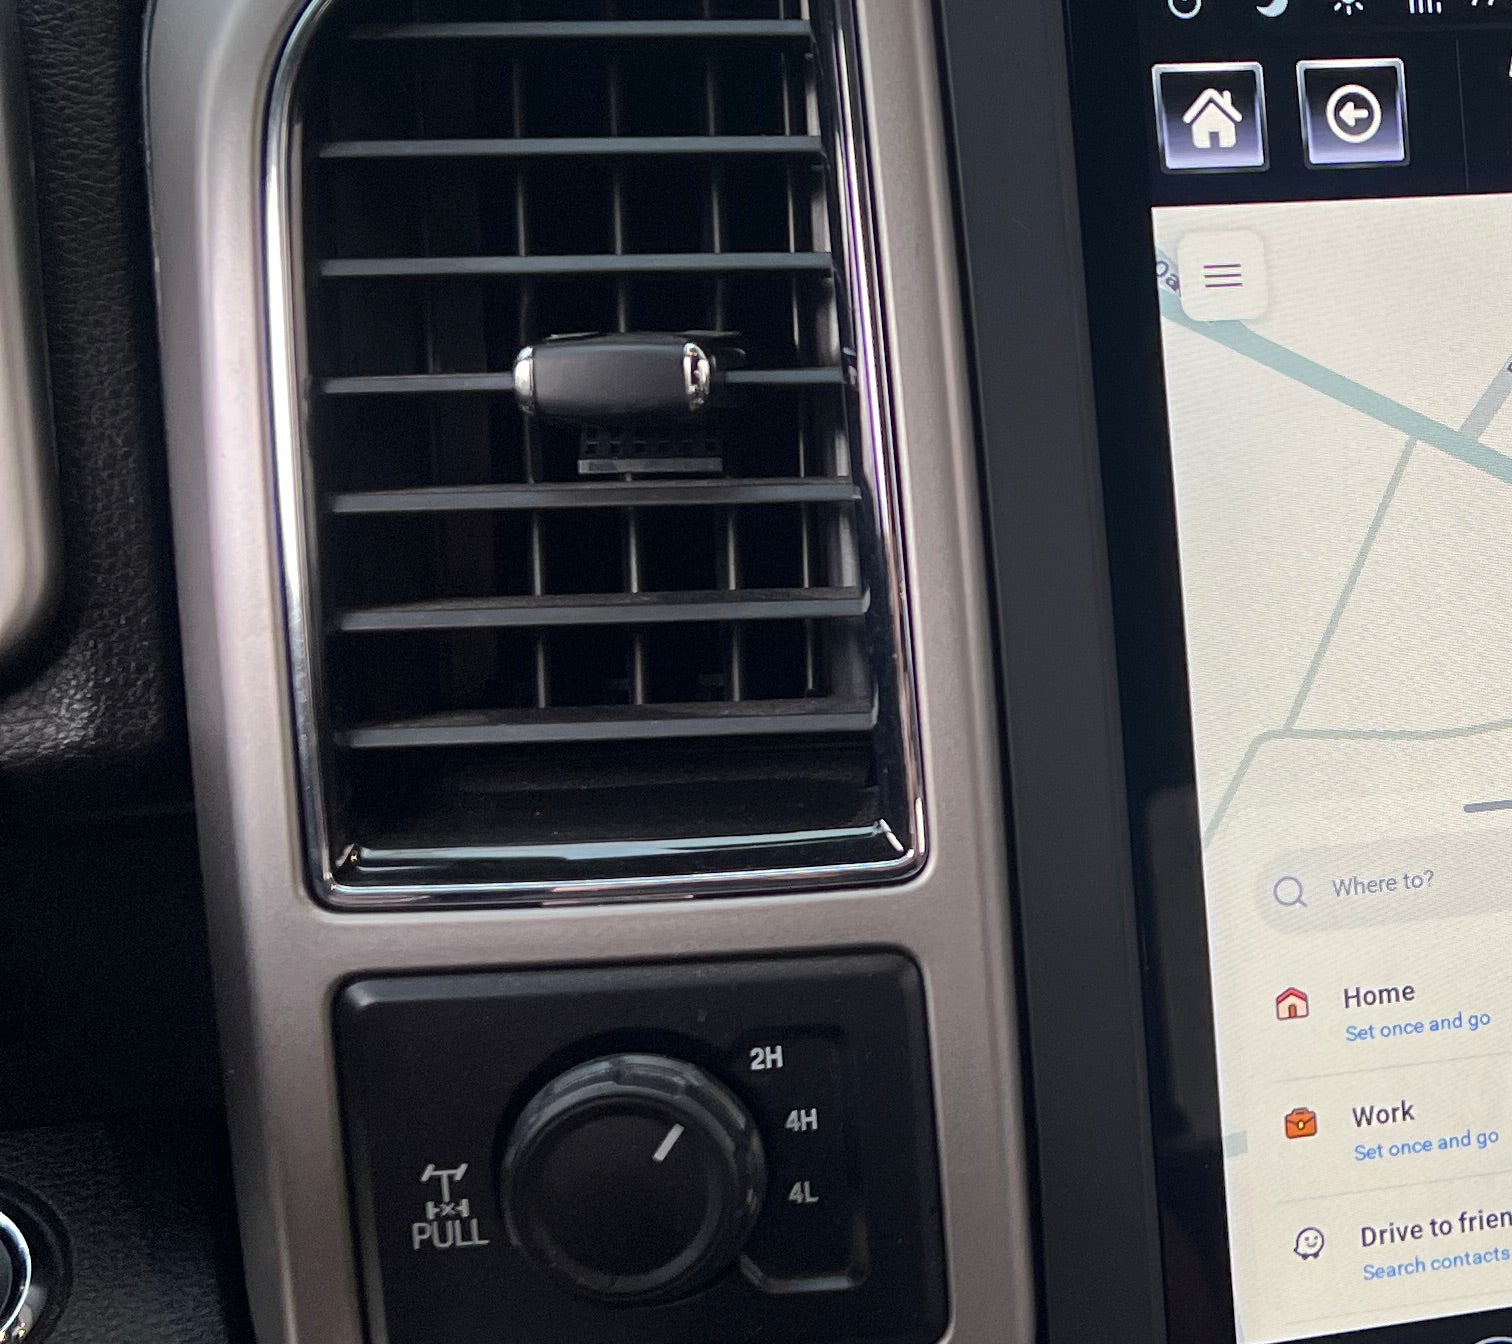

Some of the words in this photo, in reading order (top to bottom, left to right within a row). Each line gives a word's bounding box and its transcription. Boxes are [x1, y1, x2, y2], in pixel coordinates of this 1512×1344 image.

[1332, 873, 1398, 898] Where
[1401, 869, 1435, 892] to?
[1342, 983, 1416, 1009] Home
[1345, 1024, 1375, 1043] Set
[1379, 1019, 1425, 1039] once
[1428, 1011, 1463, 1034] and
[1467, 1012, 1492, 1034] go
[749, 1045, 784, 1070] 2H
[785, 1108, 818, 1132] 4H
[1352, 1099, 1416, 1128] Work
[1354, 1143, 1383, 1162] Set
[1388, 1137, 1434, 1157] once
[1437, 1129, 1473, 1151] and
[1475, 1129, 1500, 1151] go
[788, 1181, 819, 1204] 4L
[411, 1219, 490, 1251] PULL
[1360, 1216, 1425, 1248] Drive
[1429, 1215, 1454, 1239] to
[1362, 1255, 1427, 1282] Search
[1429, 1245, 1512, 1273] contacts
